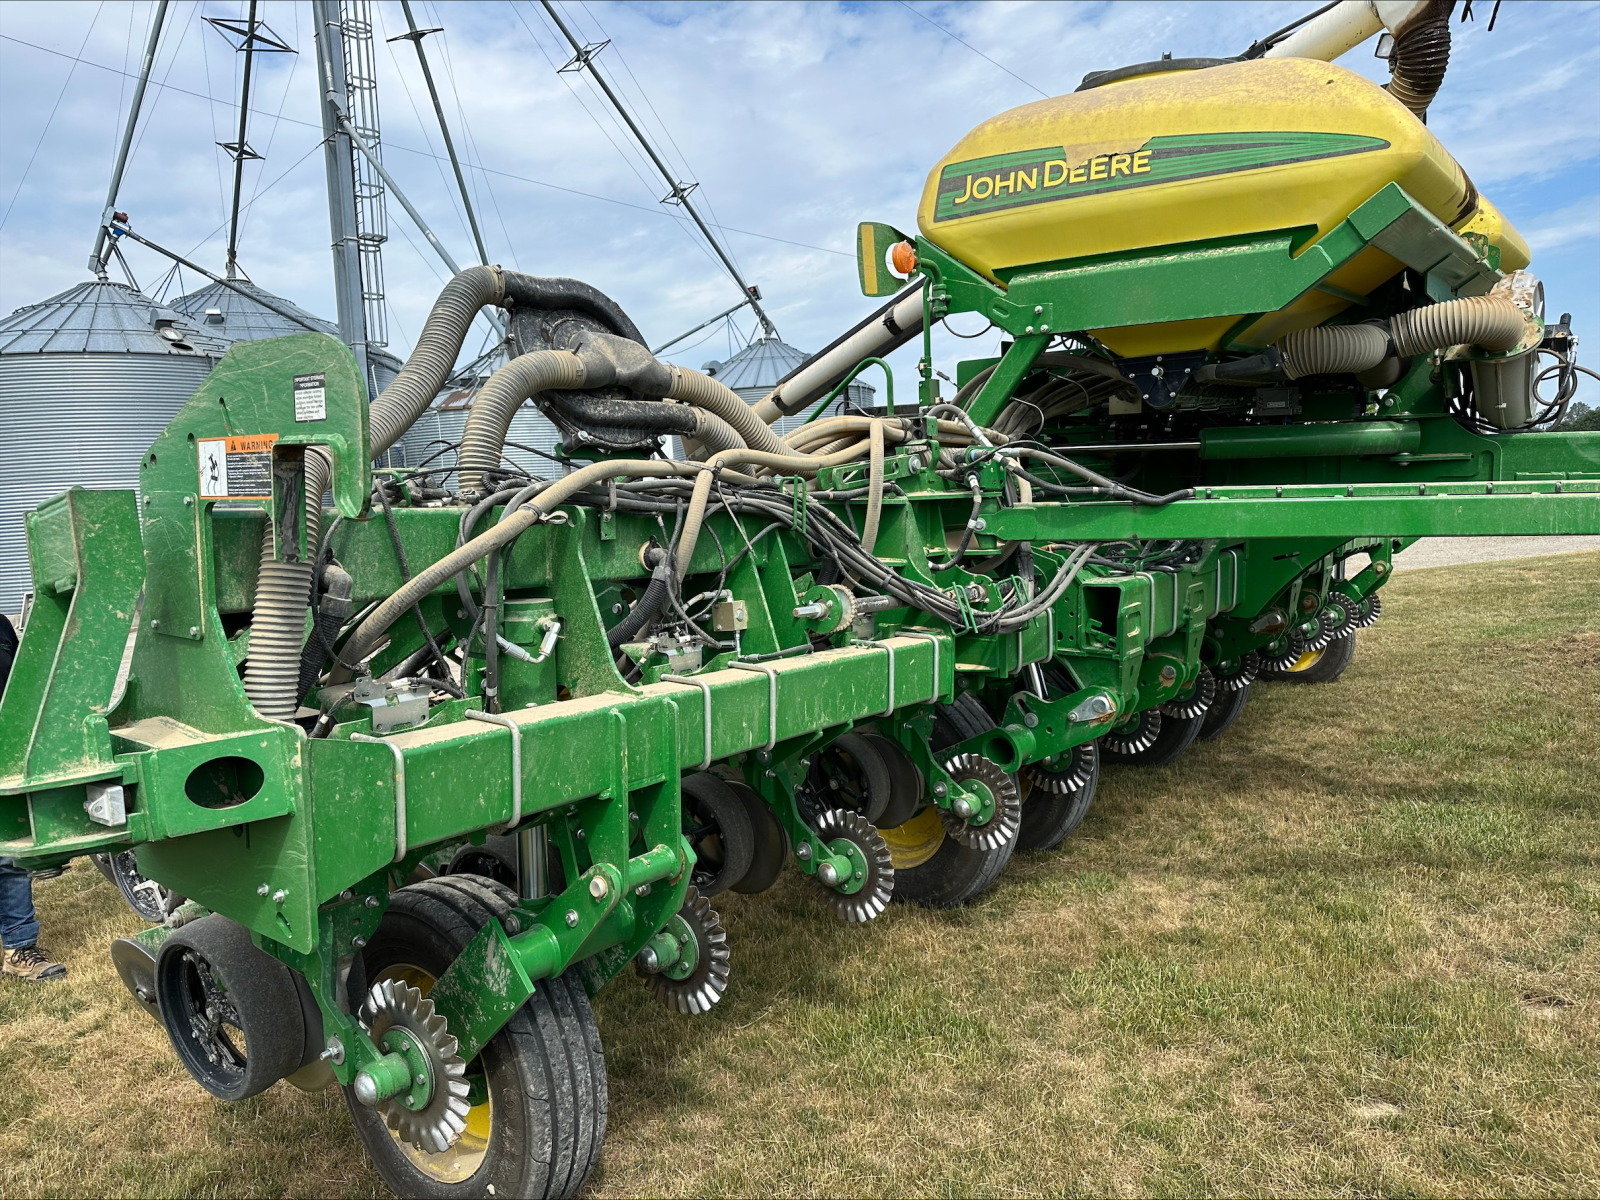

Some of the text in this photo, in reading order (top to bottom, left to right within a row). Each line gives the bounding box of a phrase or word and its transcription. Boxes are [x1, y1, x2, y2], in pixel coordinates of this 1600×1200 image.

[955, 150, 1152, 204] JOHN DEERE
[240, 440, 273, 451] WARNING
